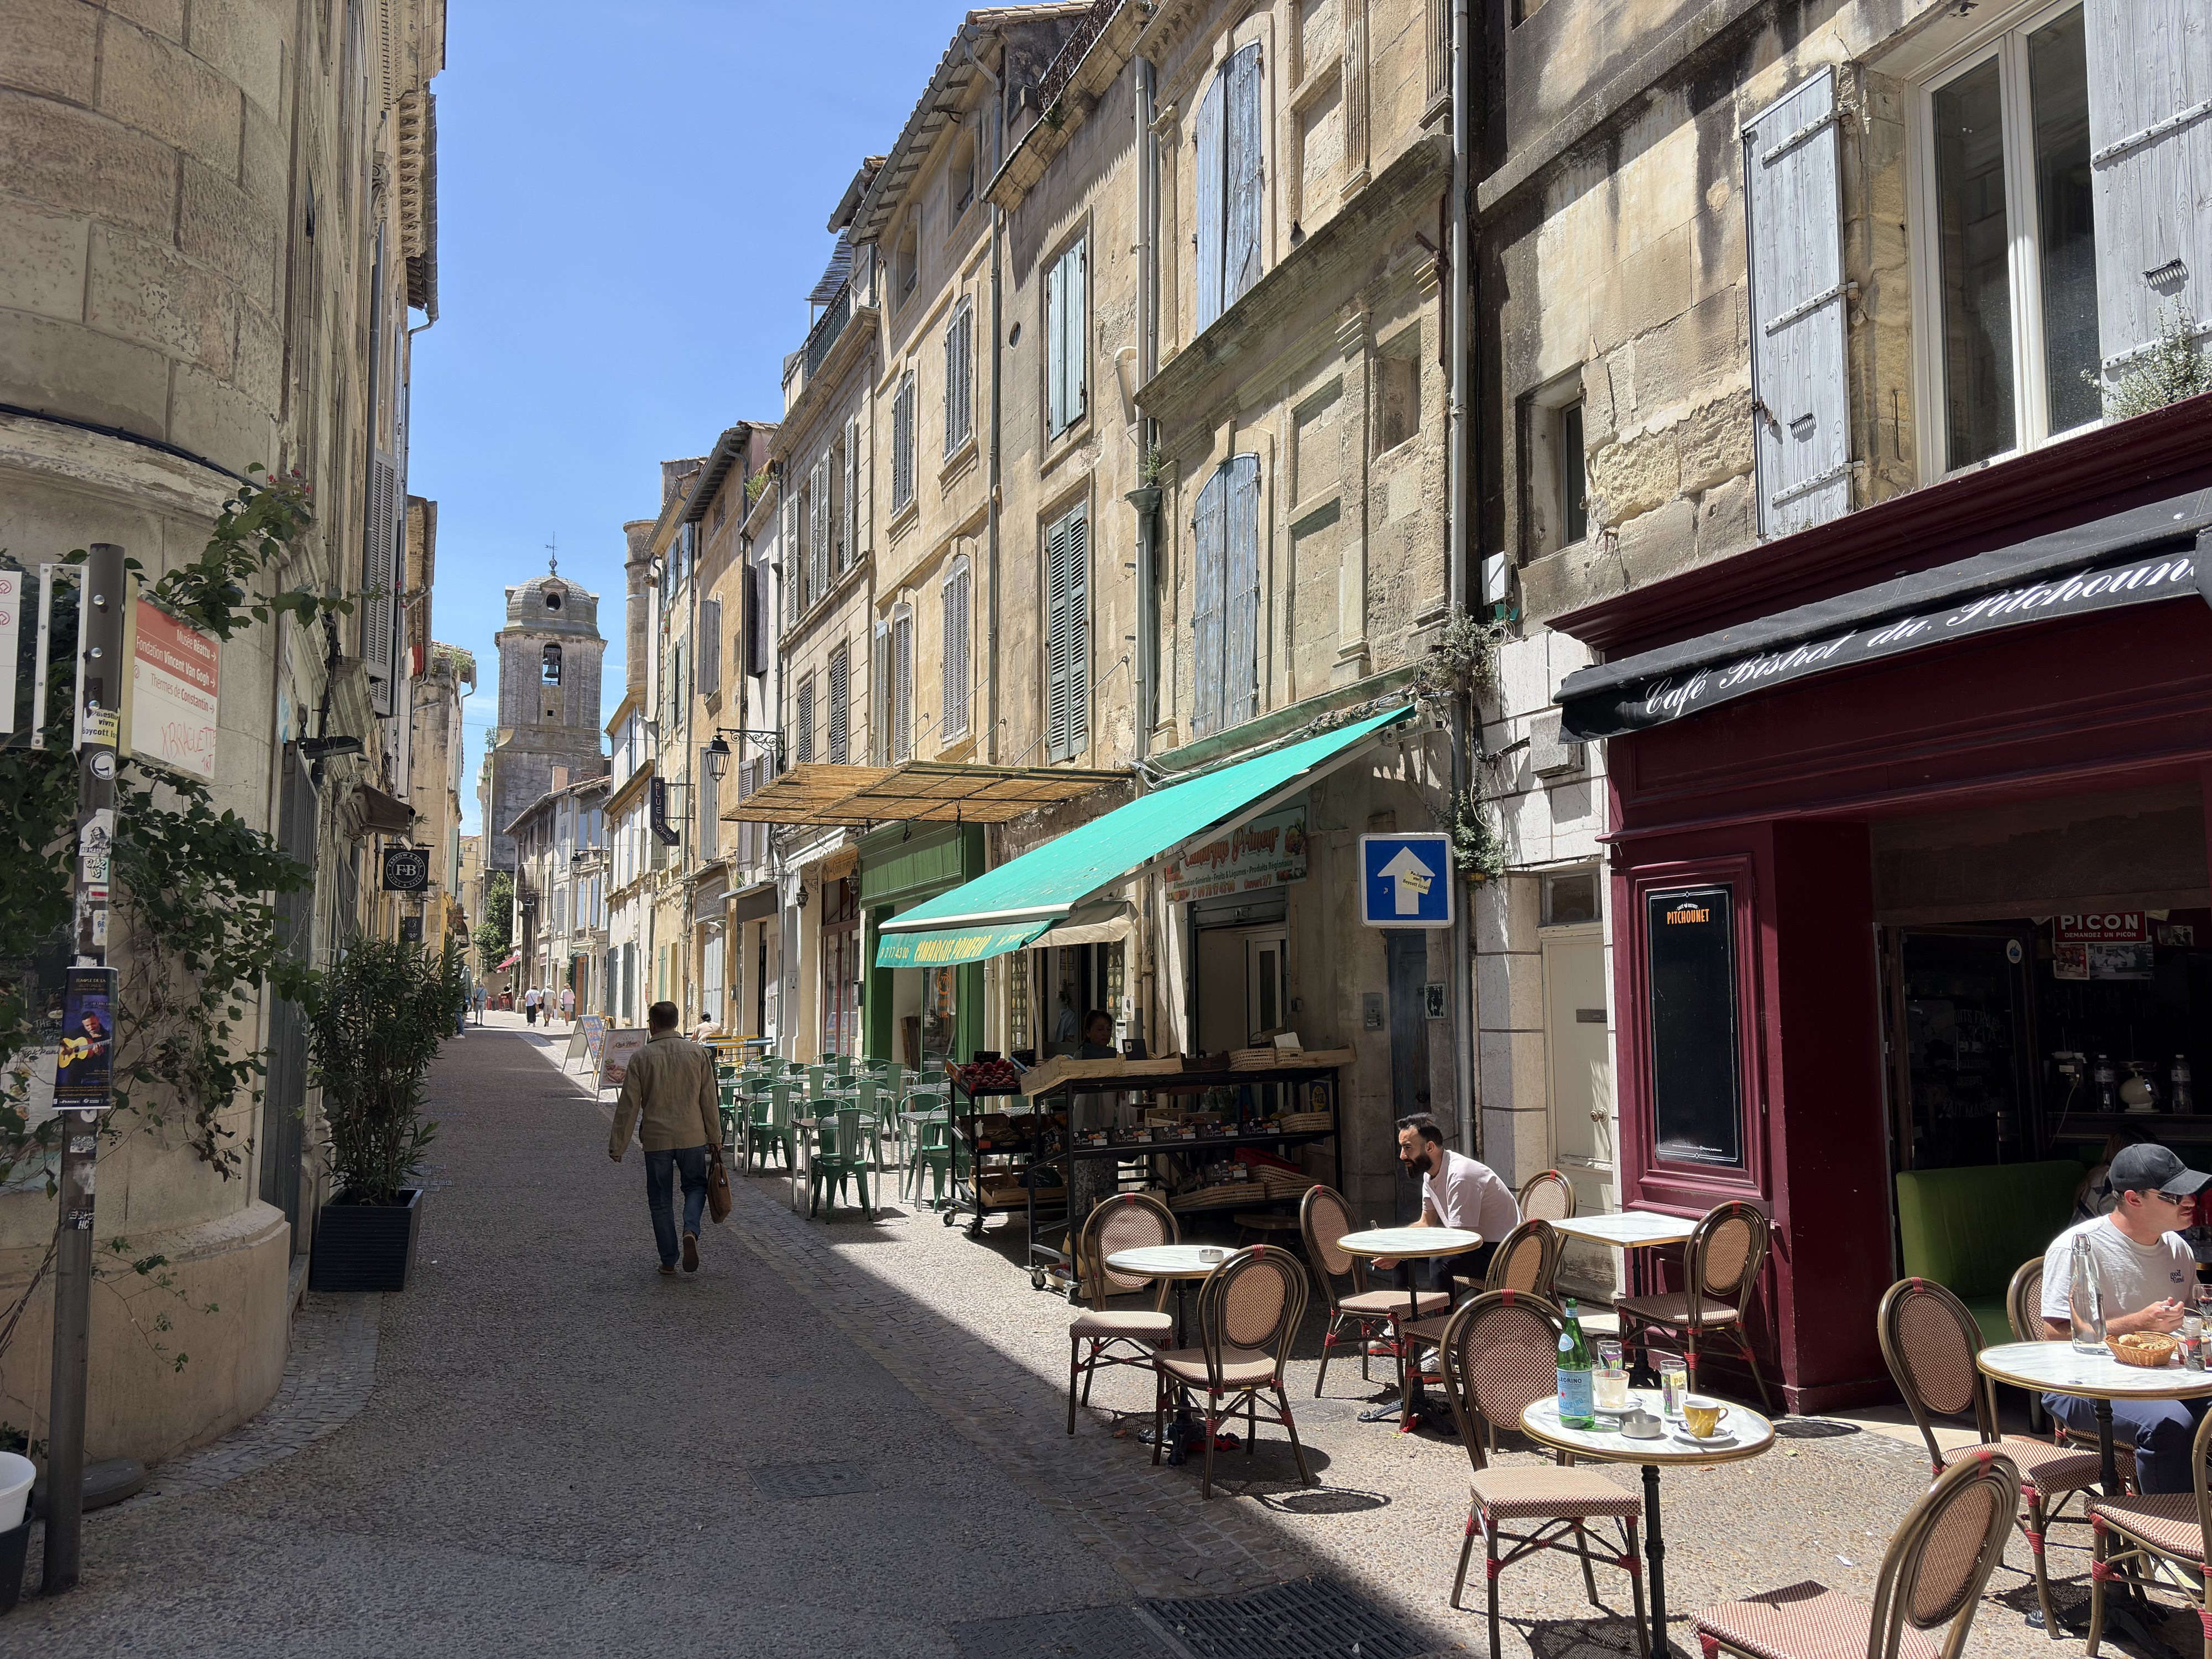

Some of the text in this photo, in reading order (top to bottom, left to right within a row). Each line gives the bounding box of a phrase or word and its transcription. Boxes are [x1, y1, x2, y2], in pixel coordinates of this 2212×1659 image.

[176, 629, 210, 659] Musée Réattu
[1646, 559, 2194, 717] Café Bistrot du Pitchoun
[136, 636, 210, 686] Fondation Vincent Van Gogh
[151, 673, 208, 712] Thermes de Constantin
[98, 719, 114, 727] vivra
[82, 727, 109, 737] Boycott
[655, 818, 674, 841] NOTE
[1232, 825, 1280, 863] Primeur
[388, 853, 408, 867] FARROW
[414, 857, 423, 868] BALL
[395, 864, 416, 876] F&B
[1173, 878, 1195, 890] Alimentation
[1195, 874, 1211, 885] Générale
[1214, 872, 1225, 881] Fruits
[1229, 869, 1246, 879] Légumes
[1249, 863, 1267, 874] Produits
[1268, 859, 1293, 872] Régionaux
[388, 873, 400, 885] PAINT
[409, 875, 422, 886] PAPER
[1244, 874, 1272, 890] Ouvert 7/7
[1403, 879, 1417, 887] Boycott
[1667, 909, 1709, 925] PITCHOUNET
[2060, 914, 2138, 930] PICON
[895, 947, 902, 959] 43
[914, 939, 954, 962] CAMARGUE
[953, 934, 992, 960] PRIMEUR
